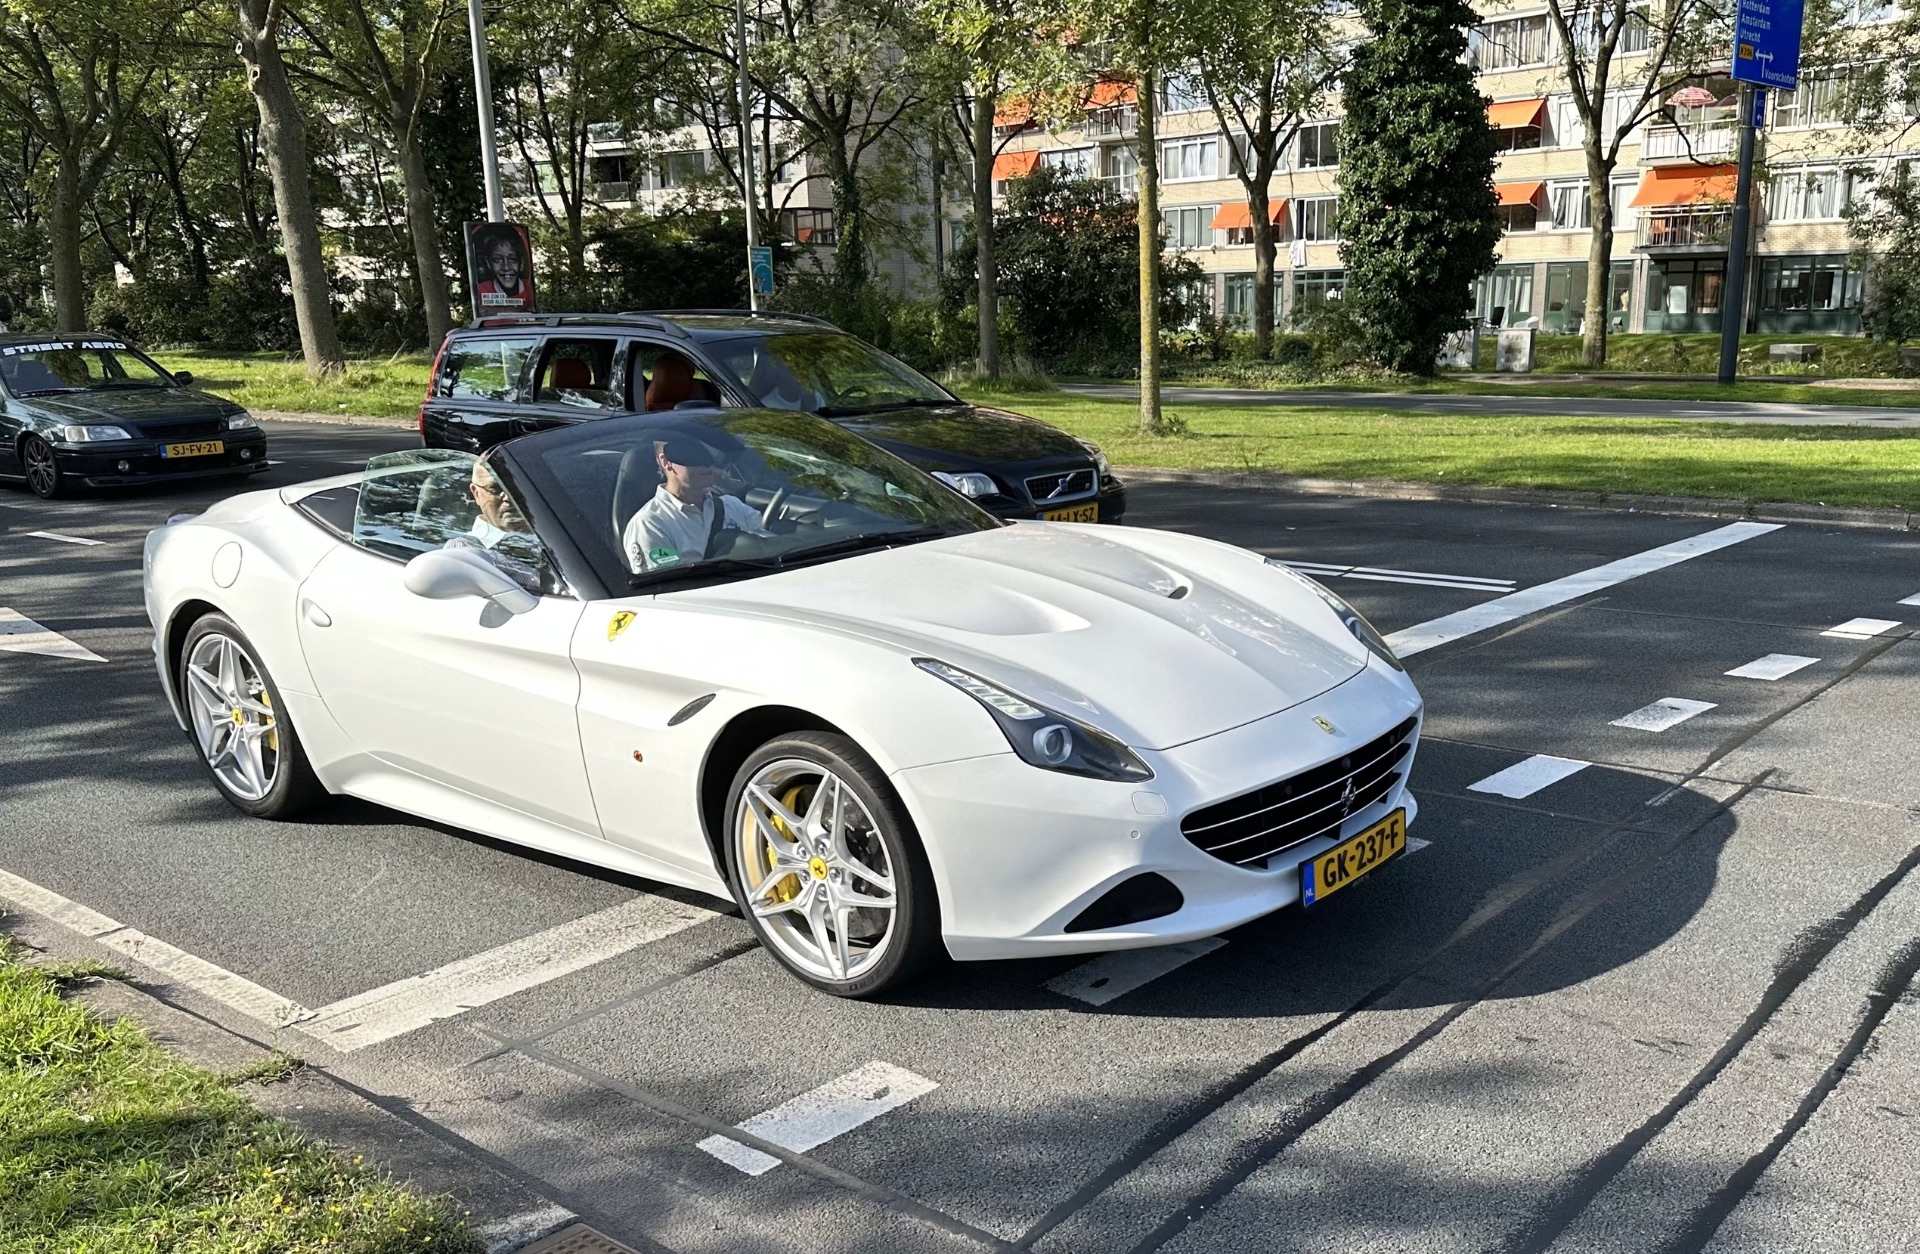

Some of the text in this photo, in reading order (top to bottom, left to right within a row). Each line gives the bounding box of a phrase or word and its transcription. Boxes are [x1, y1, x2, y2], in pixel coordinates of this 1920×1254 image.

[1742, 0, 1770, 15] Rotterdam
[1741, 13, 1770, 30] Amsterdam
[1740, 28, 1760, 43] Utrecht
[1765, 69, 1795, 84] Voorschoten
[2, 341, 127, 356] STREET AERO
[172, 443, 218, 456] SJ-FV-21
[1323, 818, 1399, 888] GK-237-F
[1305, 887, 1314, 898] NL
